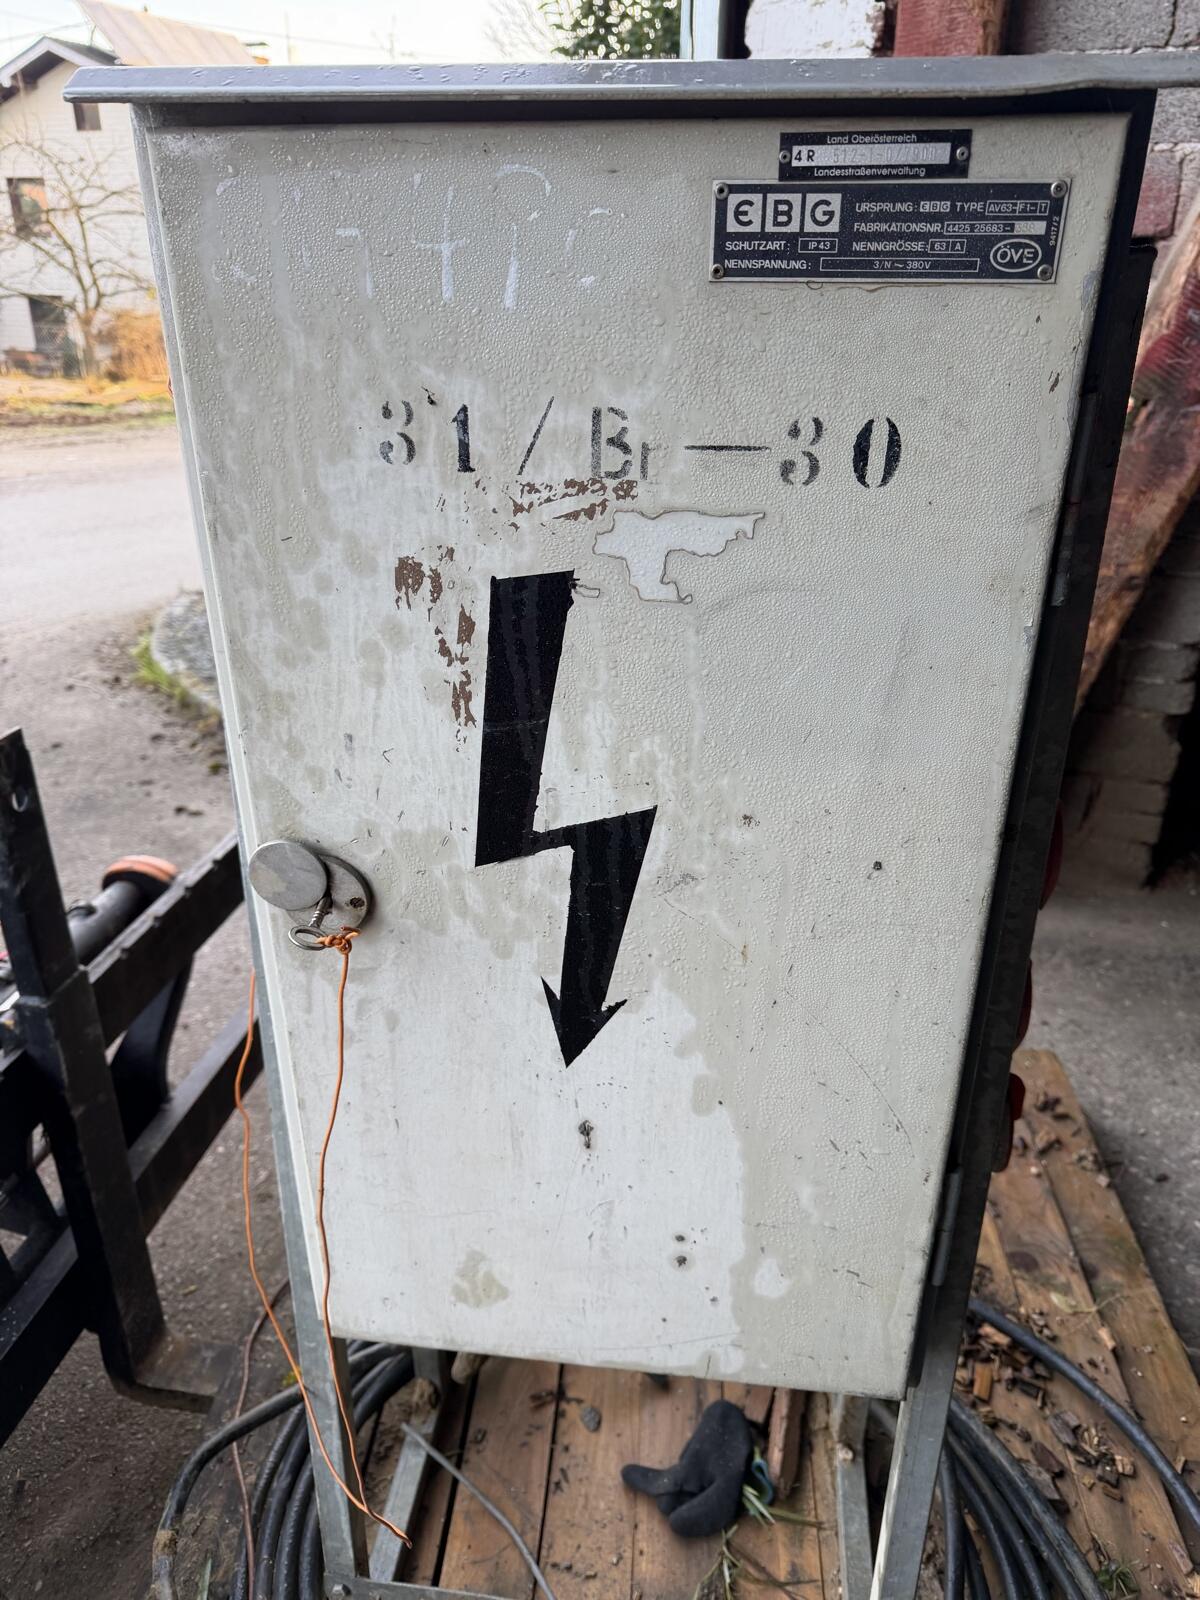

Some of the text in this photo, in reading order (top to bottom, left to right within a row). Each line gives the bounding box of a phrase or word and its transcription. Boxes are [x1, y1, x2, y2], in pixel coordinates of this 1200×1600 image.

[827, 133, 918, 144] Land Oberösterreich
[794, 149, 803, 162] 4
[806, 149, 816, 162] R
[814, 166, 926, 177] Landesstraßenverwaltung
[955, 201, 985, 212] TYPE
[853, 221, 944, 232] FABRIKATIONSNR.
[947, 224, 971, 233] 4425
[934, 242, 946, 251] 63
[954, 242, 962, 251] A
[996, 245, 1035, 263] ÖVE
[906, 261, 931, 269] 380V
